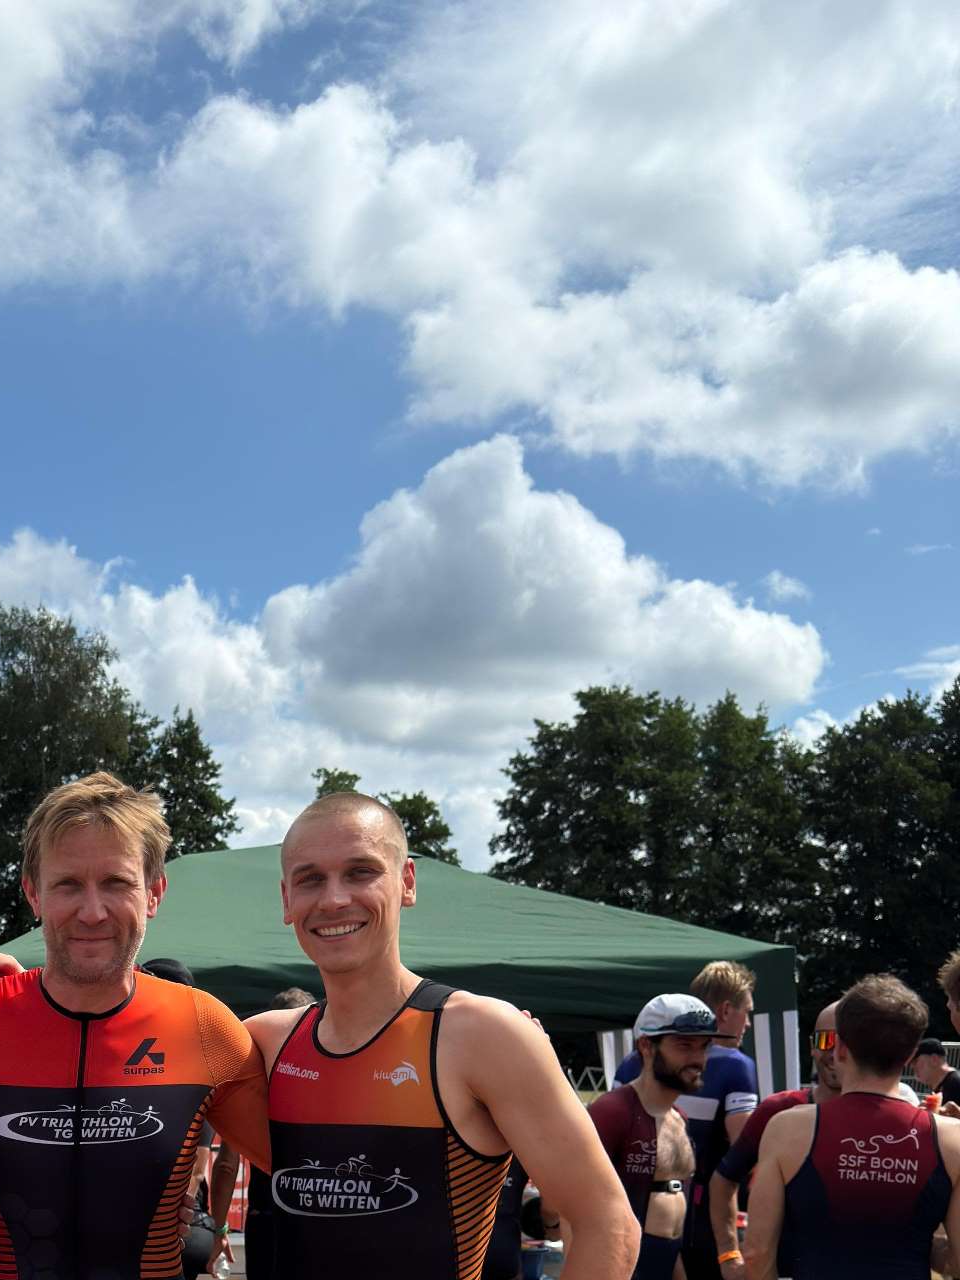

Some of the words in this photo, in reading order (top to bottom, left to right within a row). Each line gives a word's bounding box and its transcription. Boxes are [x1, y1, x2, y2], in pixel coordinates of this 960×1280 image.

[123, 1067, 165, 1077] surpas
[19, 1116, 39, 1127] PV
[54, 1128, 73, 1139] TG
[81, 1127, 137, 1138] WITTEN
[626, 1154, 650, 1164] SSF
[838, 1154, 868, 1167] SSF
[870, 1158, 918, 1171] BONN
[838, 1169, 917, 1184] TRIATHLON
[279, 1175, 291, 1190] PV
[292, 1177, 372, 1194] TRIATHLON
[299, 1193, 313, 1207] TG
[317, 1194, 381, 1210] WITTEN
